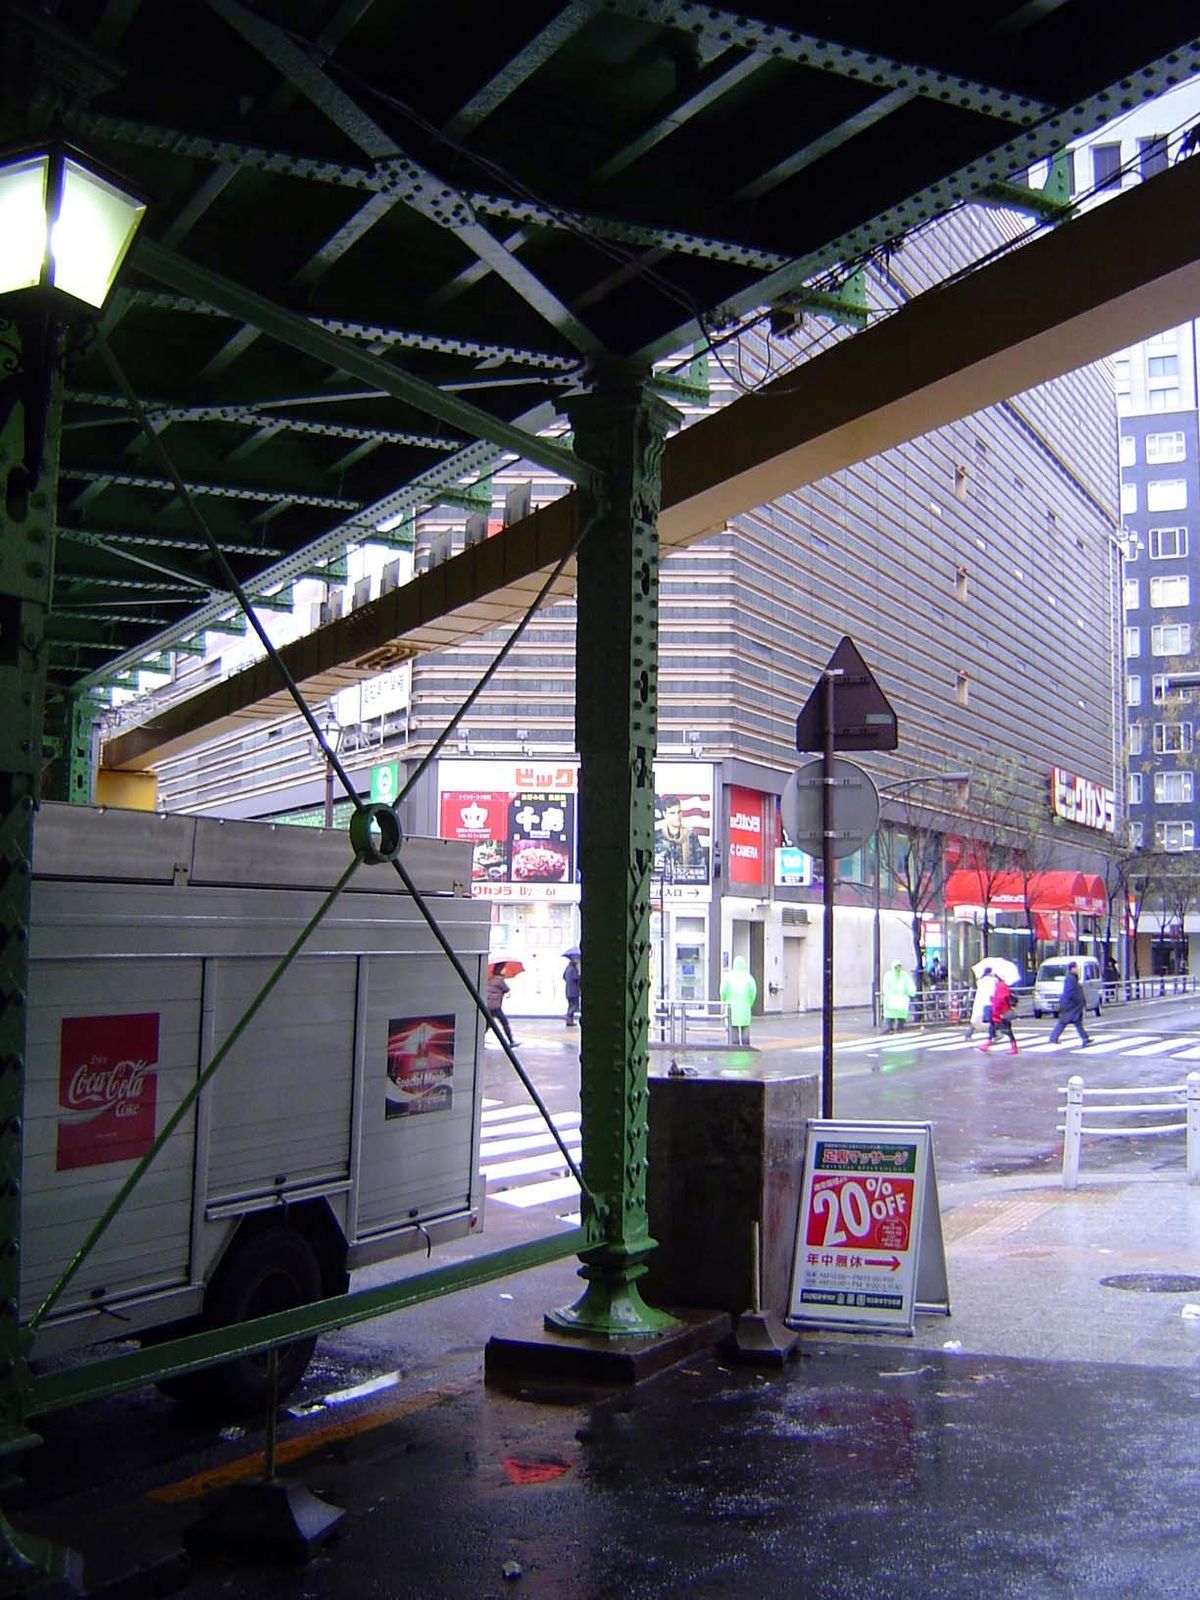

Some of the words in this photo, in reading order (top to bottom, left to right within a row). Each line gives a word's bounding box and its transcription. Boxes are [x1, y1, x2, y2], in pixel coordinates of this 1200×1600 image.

[515, 768, 573, 787] ビック
[1054, 767, 1114, 833] ビックカメラ
[68, 1060, 147, 1105] Coca-Cola
[871, 1193, 906, 1220] OFF
[807, 1252, 863, 1269] 年中無休
